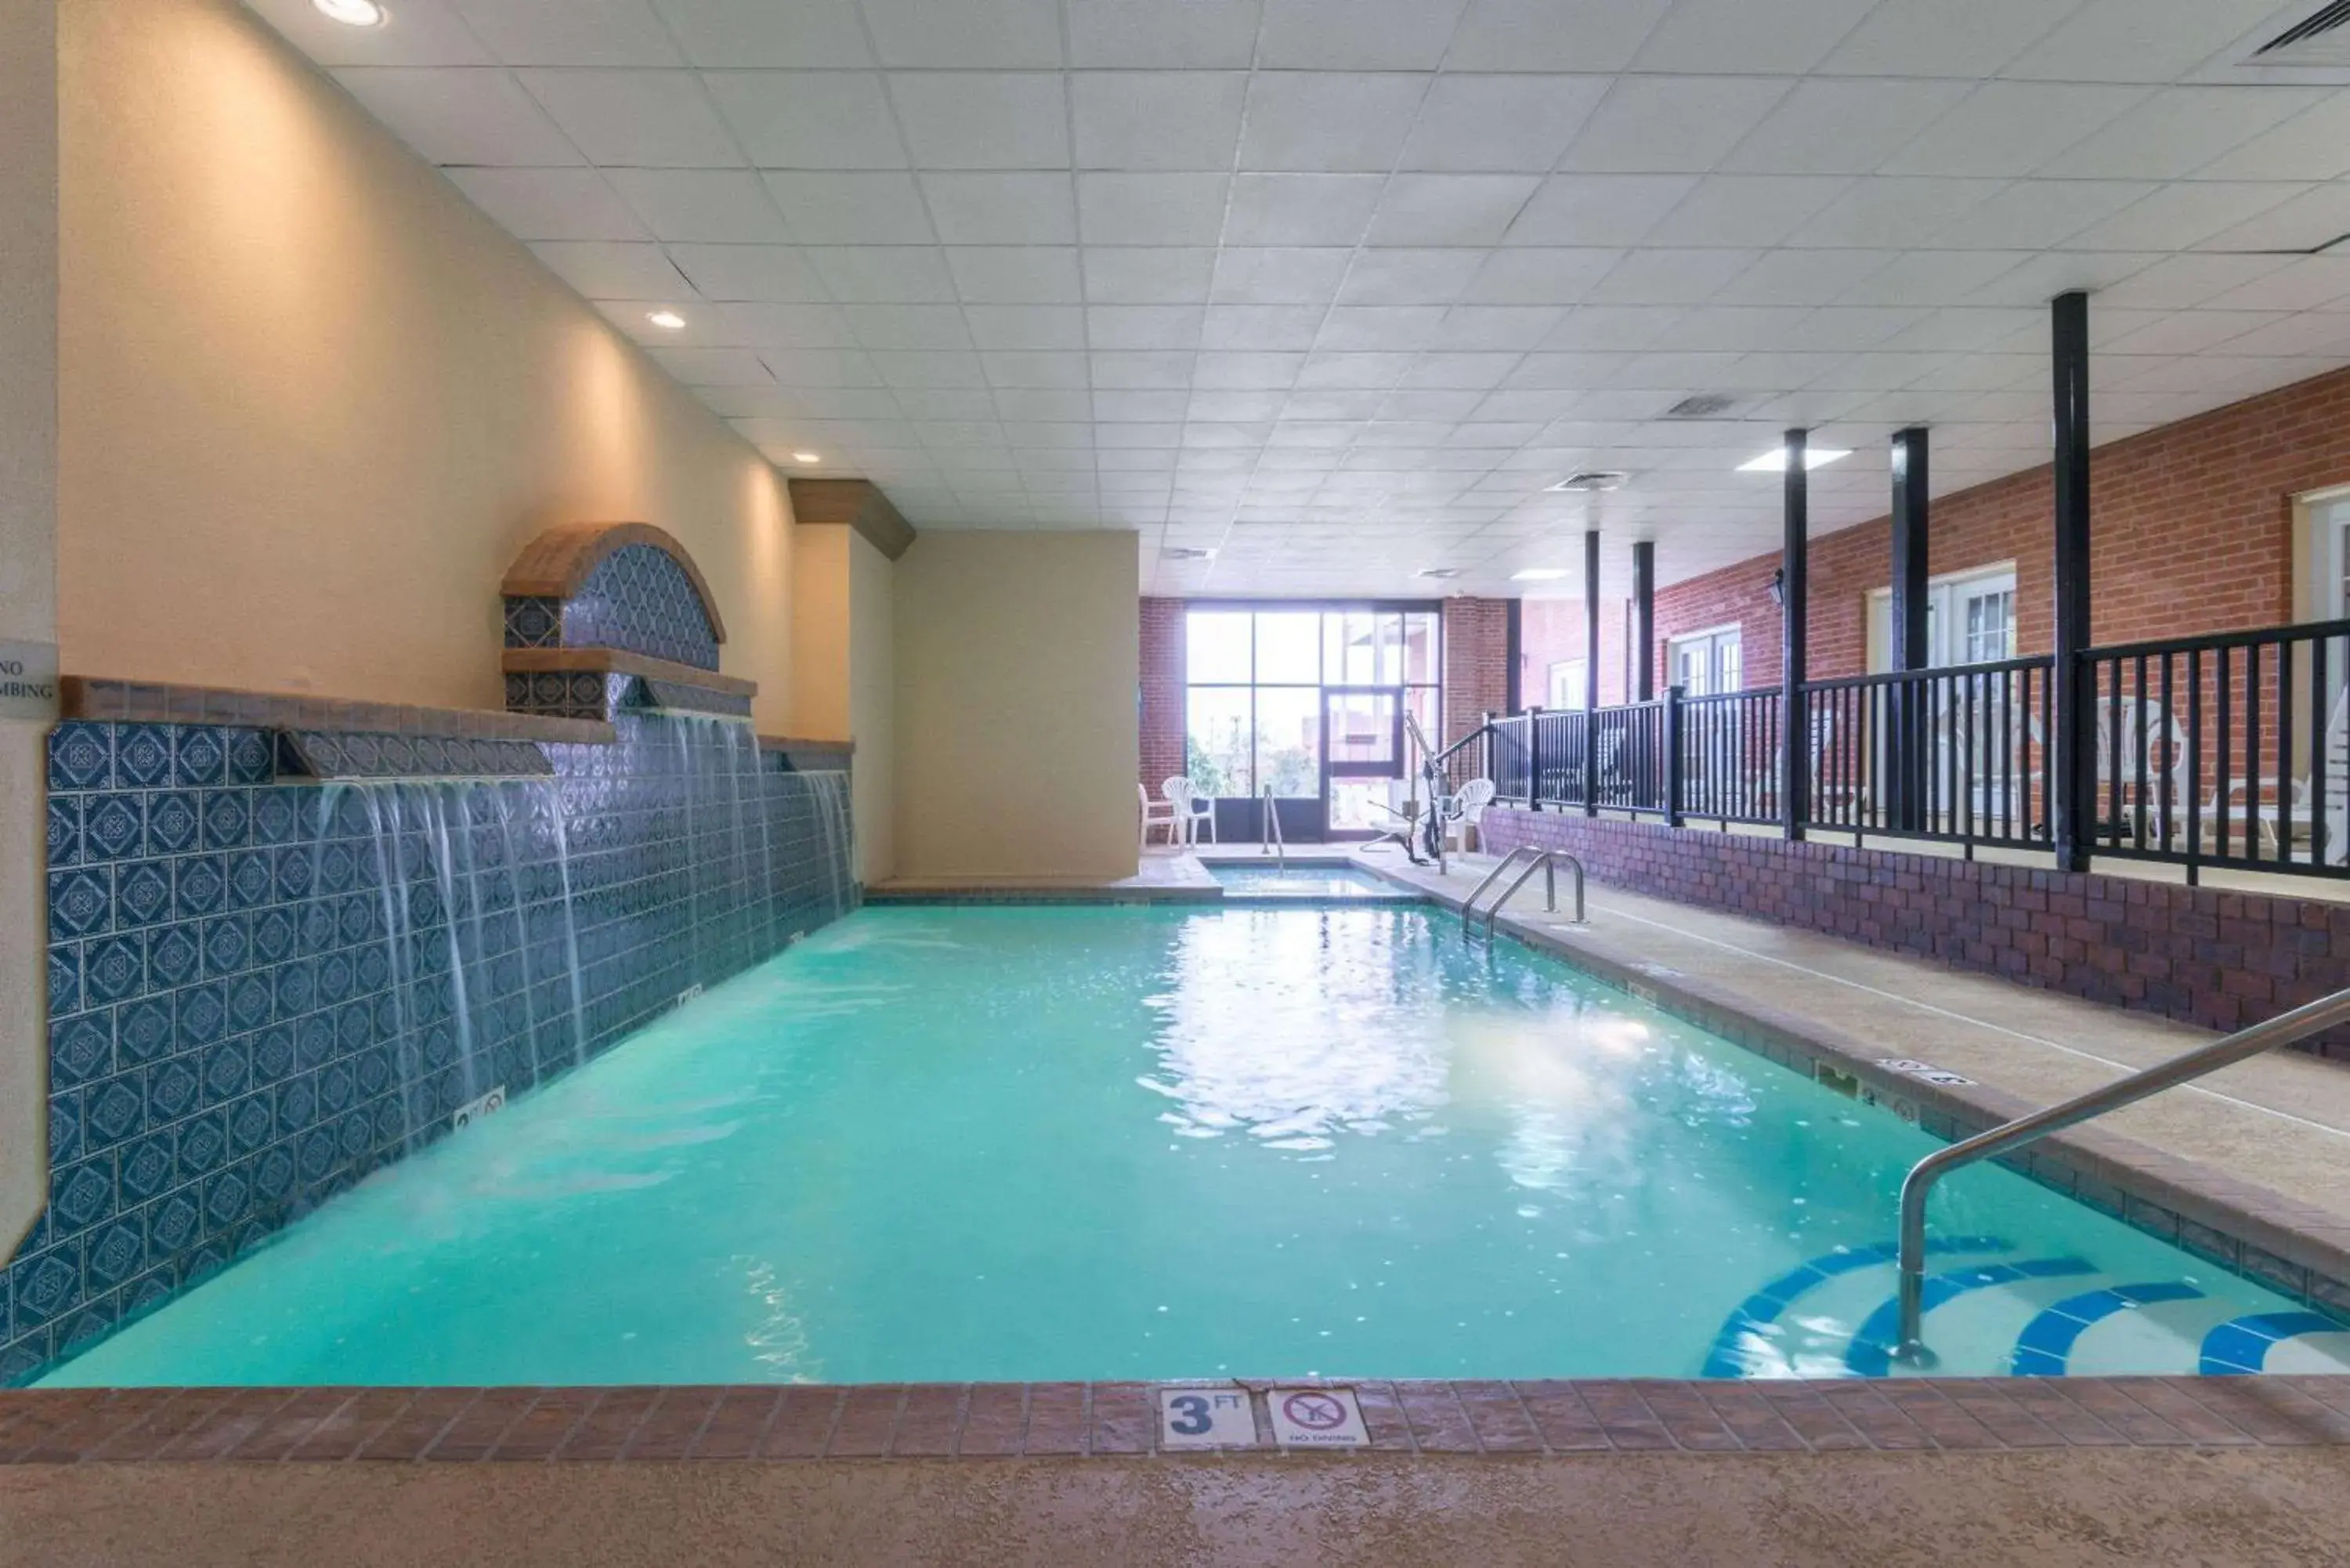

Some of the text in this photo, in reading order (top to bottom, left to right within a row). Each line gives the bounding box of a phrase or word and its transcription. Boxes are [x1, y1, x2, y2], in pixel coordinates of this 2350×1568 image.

[0, 661, 24, 675] NO
[1170, 1394, 1242, 1436] 3 FT
